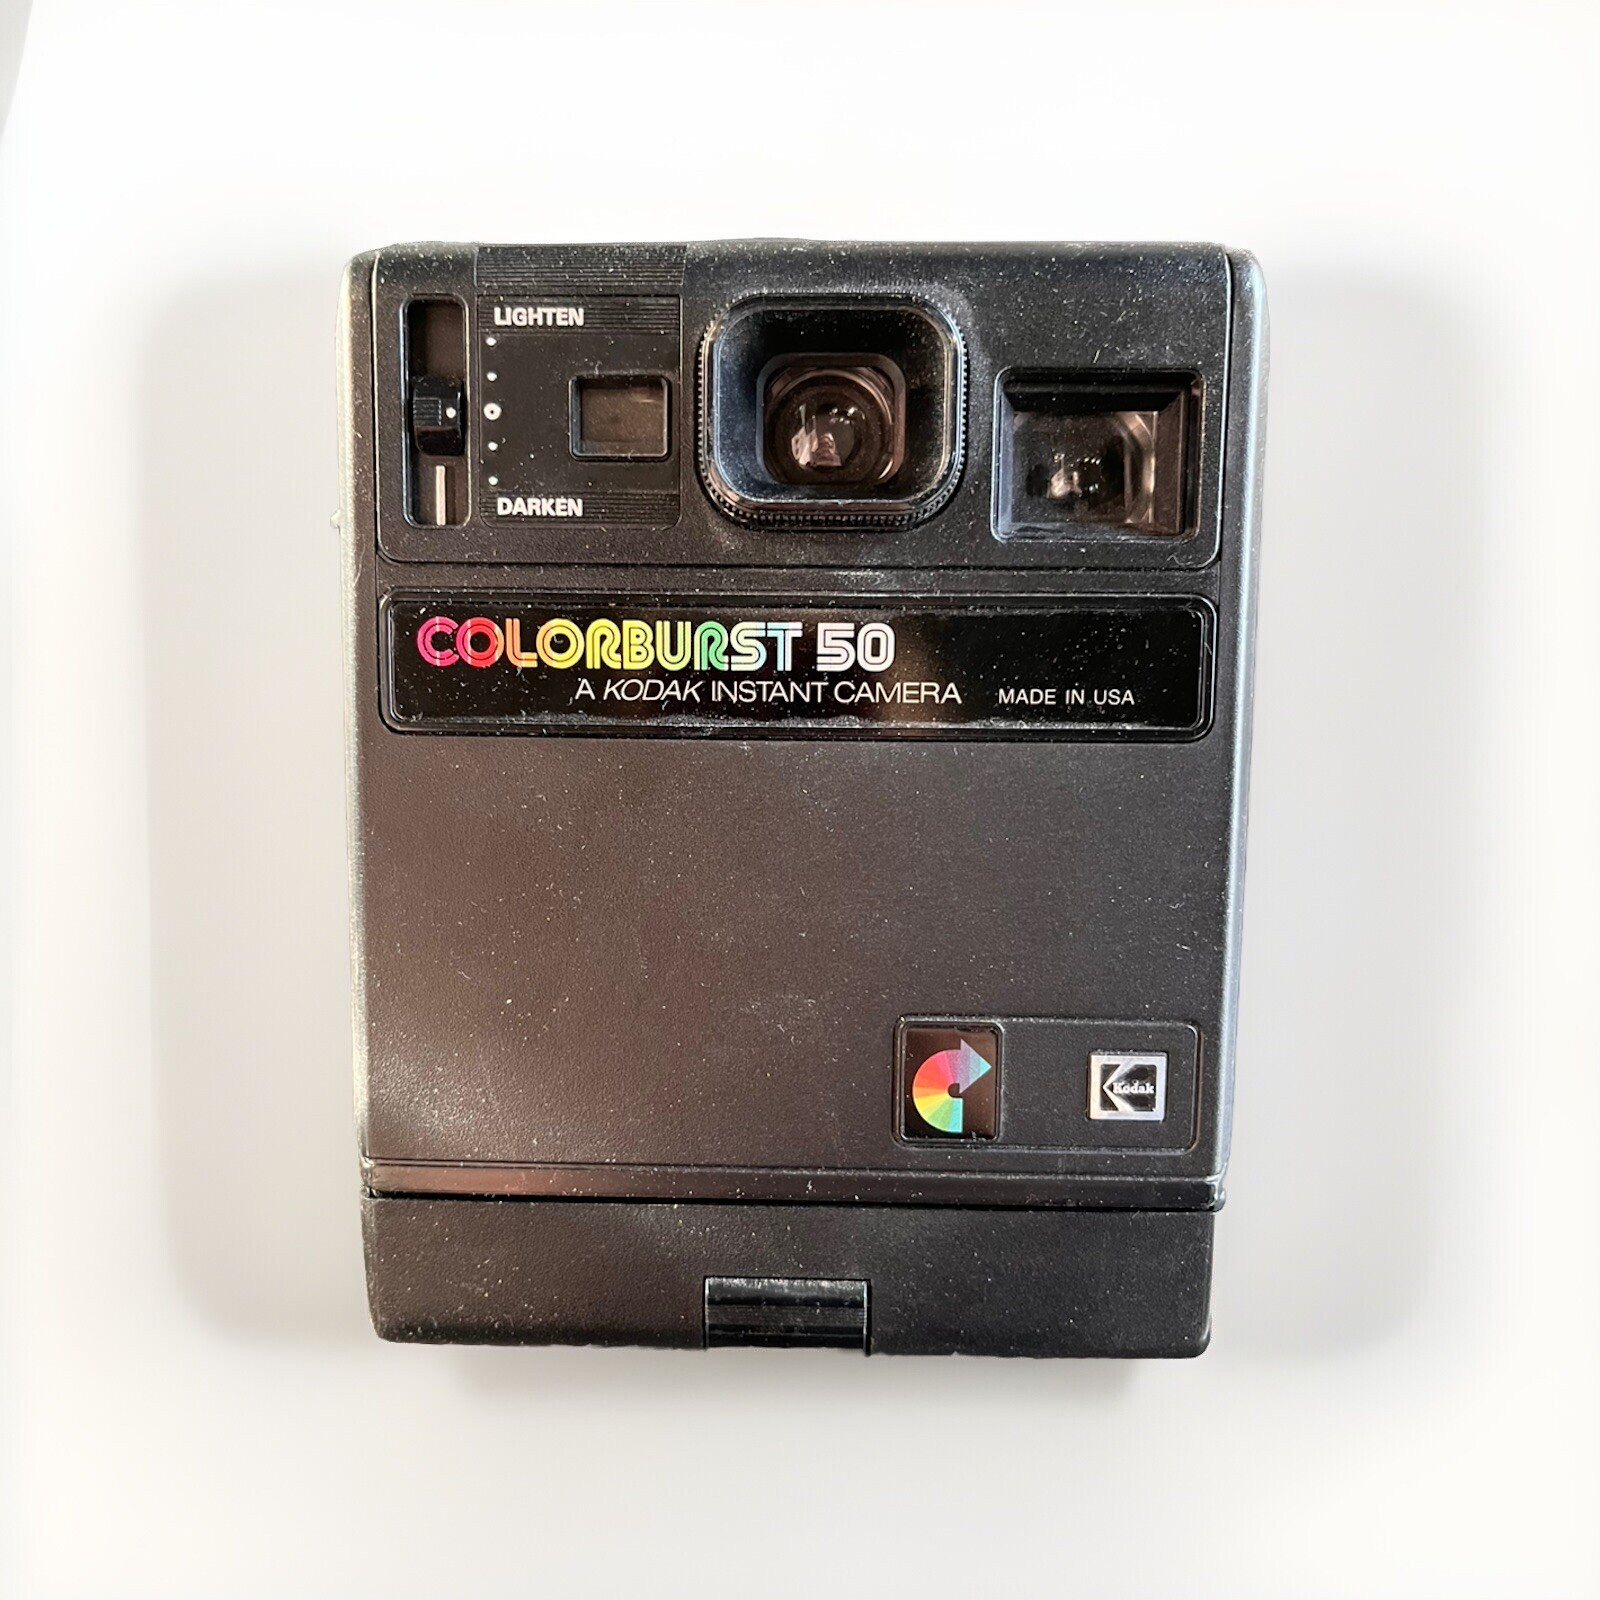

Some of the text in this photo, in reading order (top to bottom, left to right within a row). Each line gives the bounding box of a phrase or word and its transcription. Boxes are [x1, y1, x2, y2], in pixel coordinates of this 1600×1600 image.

[494, 307, 585, 327] LIGHTEN
[496, 497, 584, 518] DARKEN
[417, 616, 896, 672] COLORBURST 50
[574, 679, 963, 705] A KODAK INSTANT CAMERA
[998, 688, 1136, 707] MADE IN USA
[1112, 1081, 1155, 1095] Kodak
